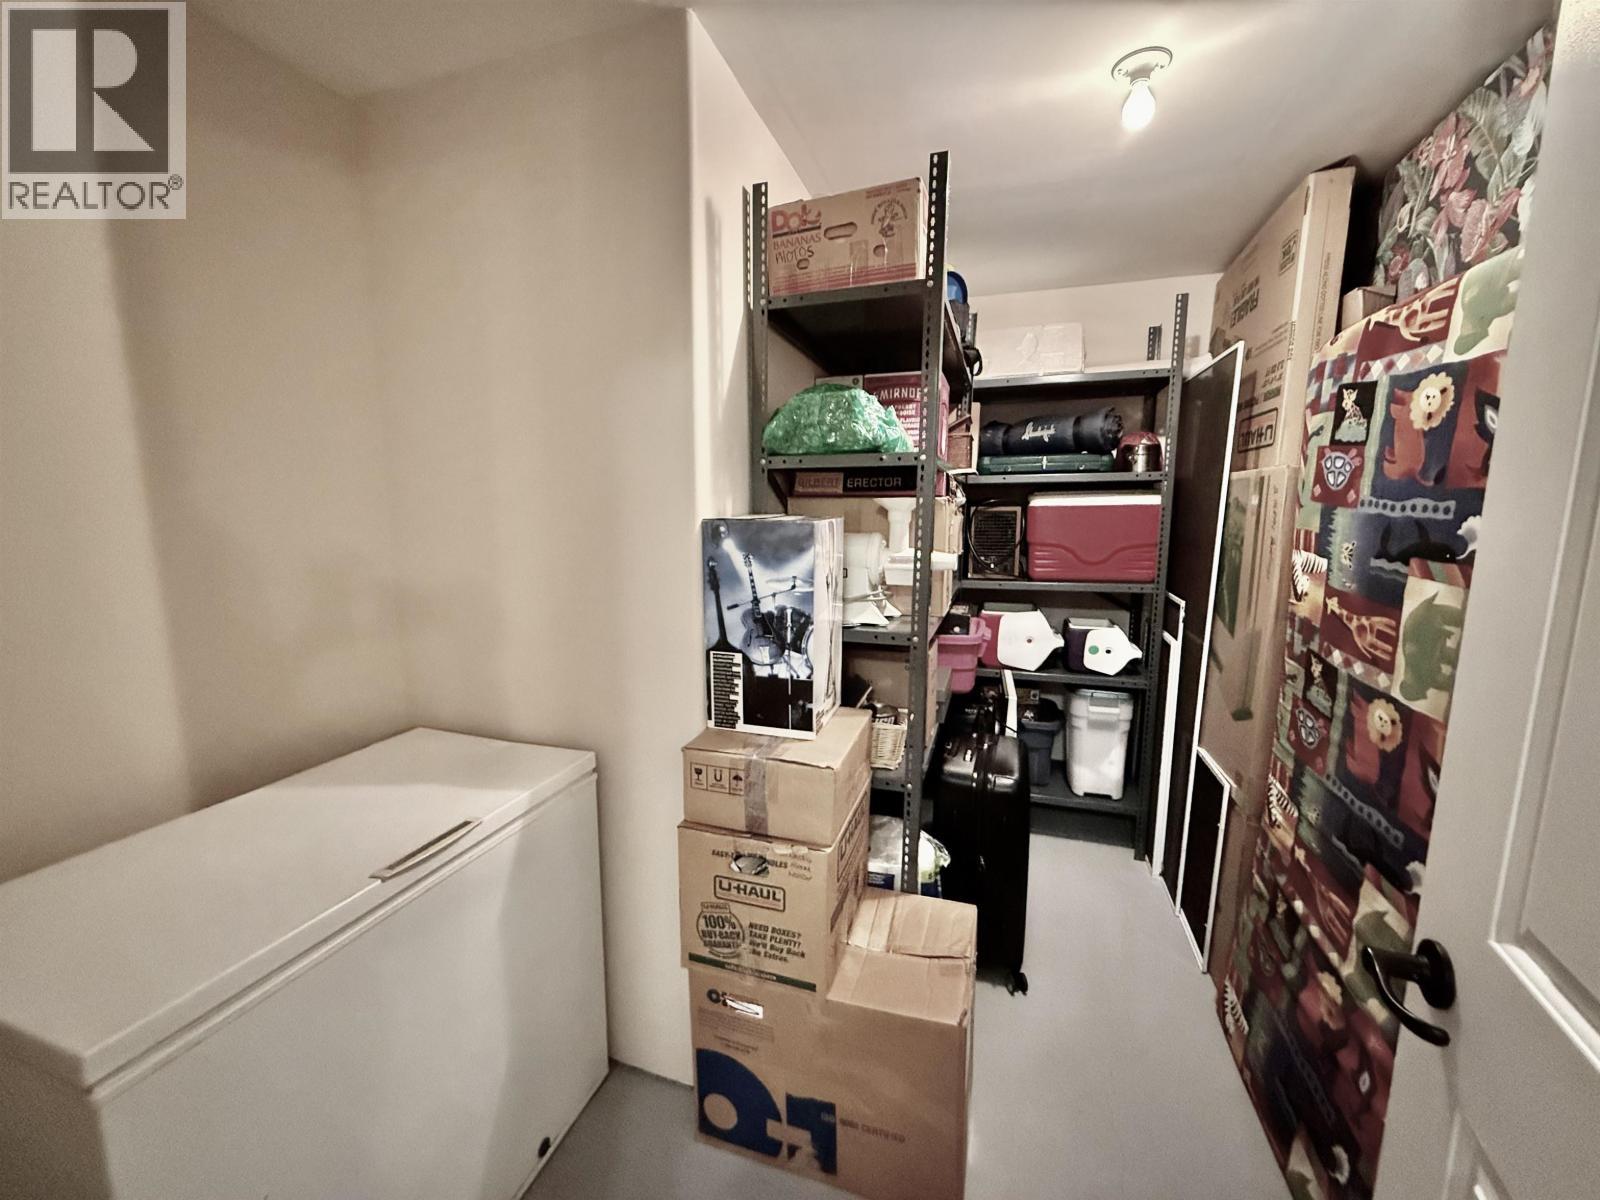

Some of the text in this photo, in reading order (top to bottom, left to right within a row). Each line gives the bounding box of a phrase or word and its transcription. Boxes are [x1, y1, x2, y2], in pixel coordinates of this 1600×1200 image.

[773, 232, 822, 251] BANANAS
[846, 477, 902, 488] ERECTOR
[719, 880, 782, 902] U-HAUL
[702, 914, 737, 930] 100%
[749, 922, 769, 932] NEED
[749, 930, 767, 941] TAKE
